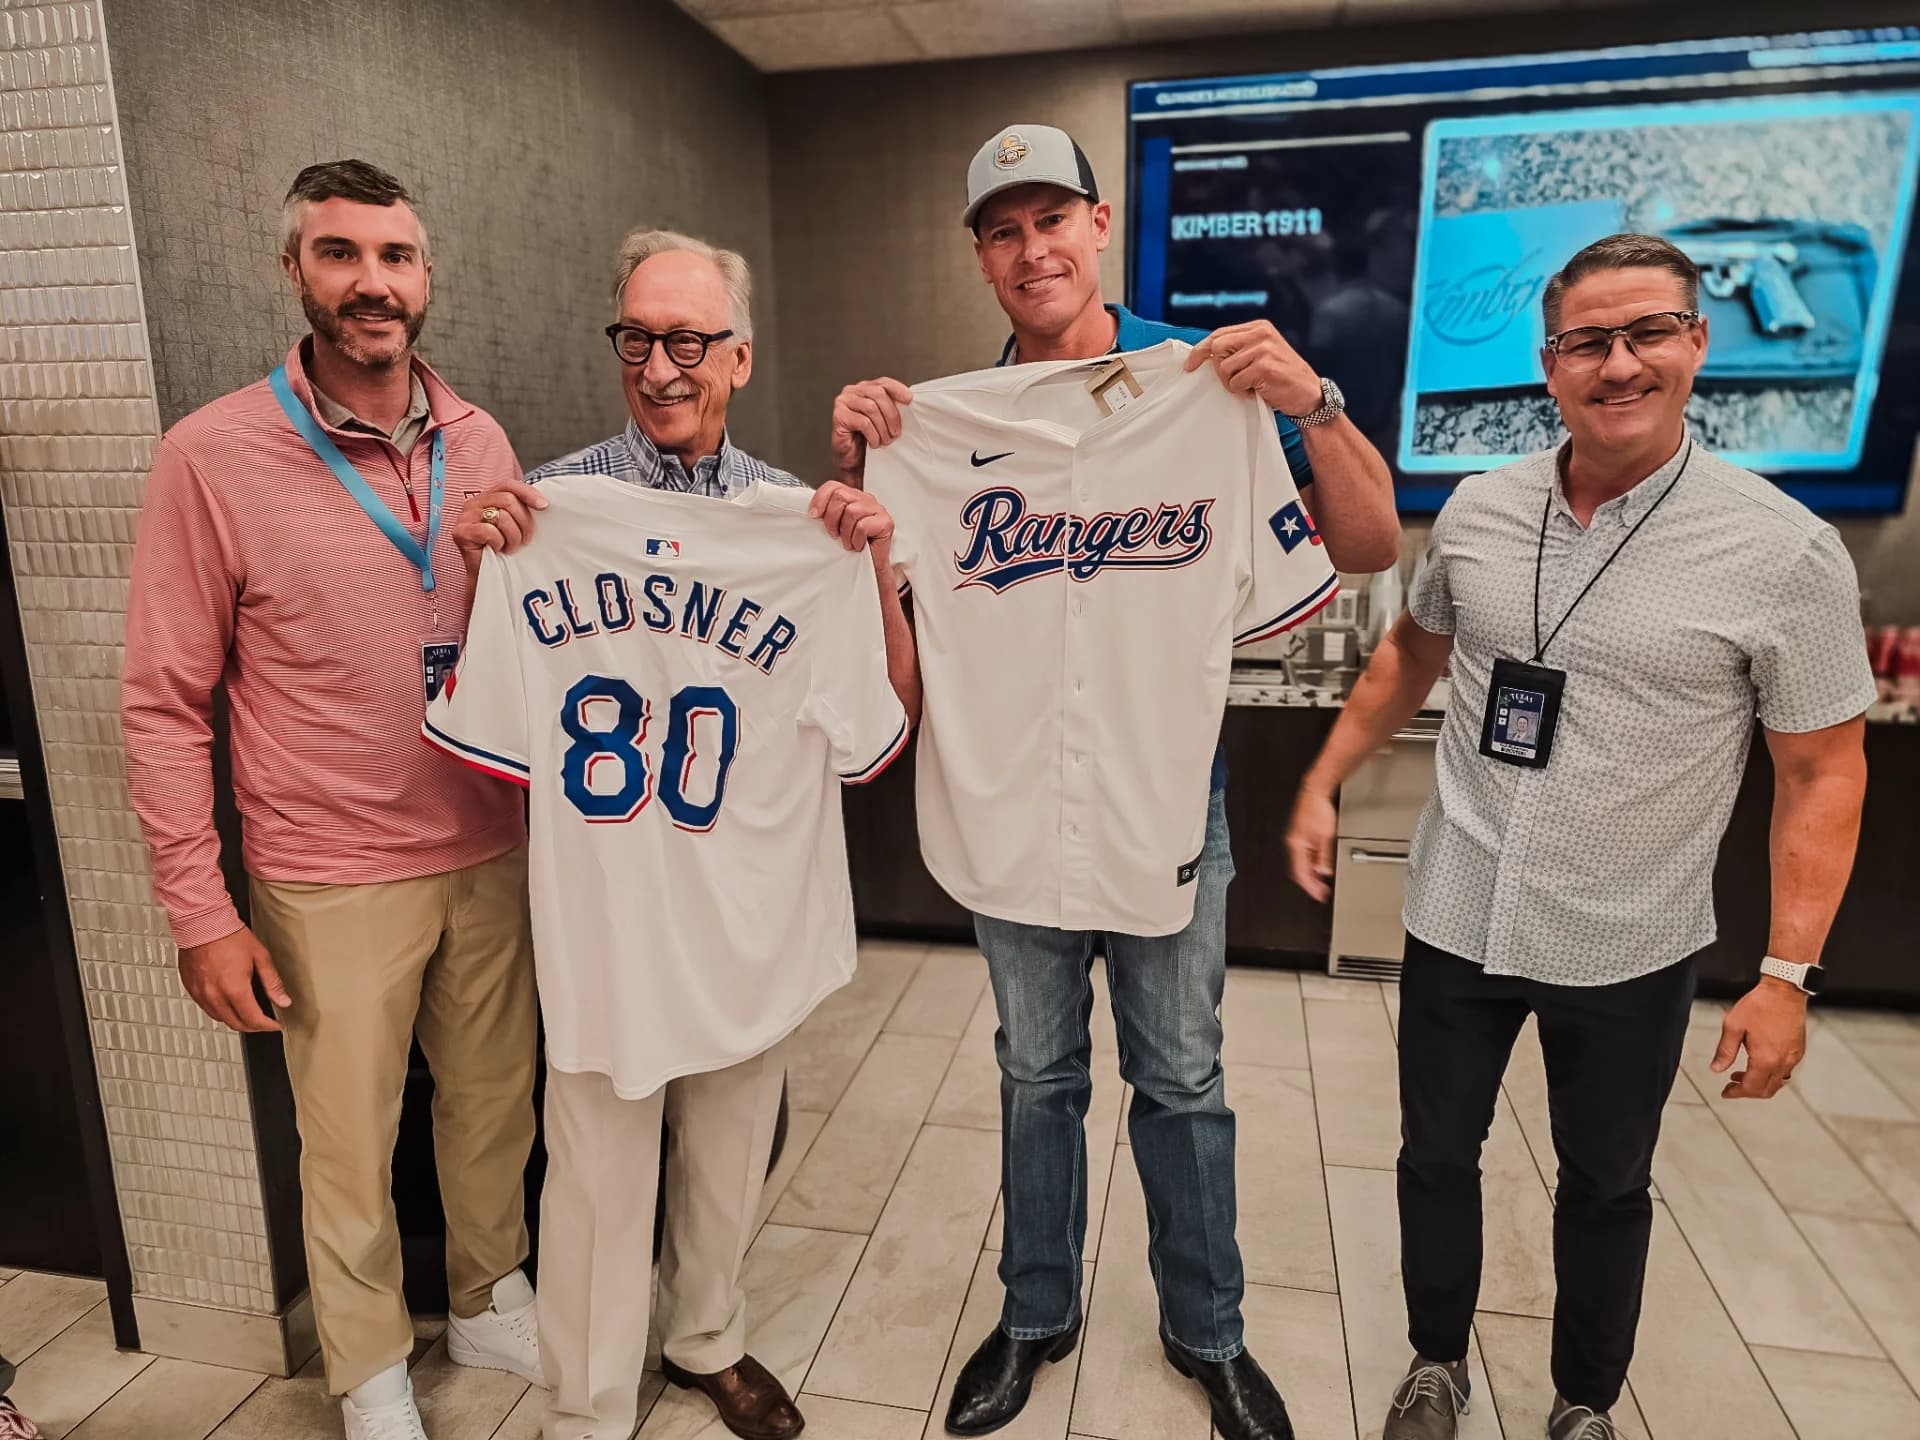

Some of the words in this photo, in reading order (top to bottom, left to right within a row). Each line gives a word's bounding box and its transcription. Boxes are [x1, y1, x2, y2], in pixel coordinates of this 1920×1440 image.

[1171, 211, 1263, 240] KIMBER
[1264, 207, 1323, 236] 1911
[954, 486, 1216, 594] Rangers
[522, 572, 798, 675] CLOSNER
[560, 674, 742, 833] 80
